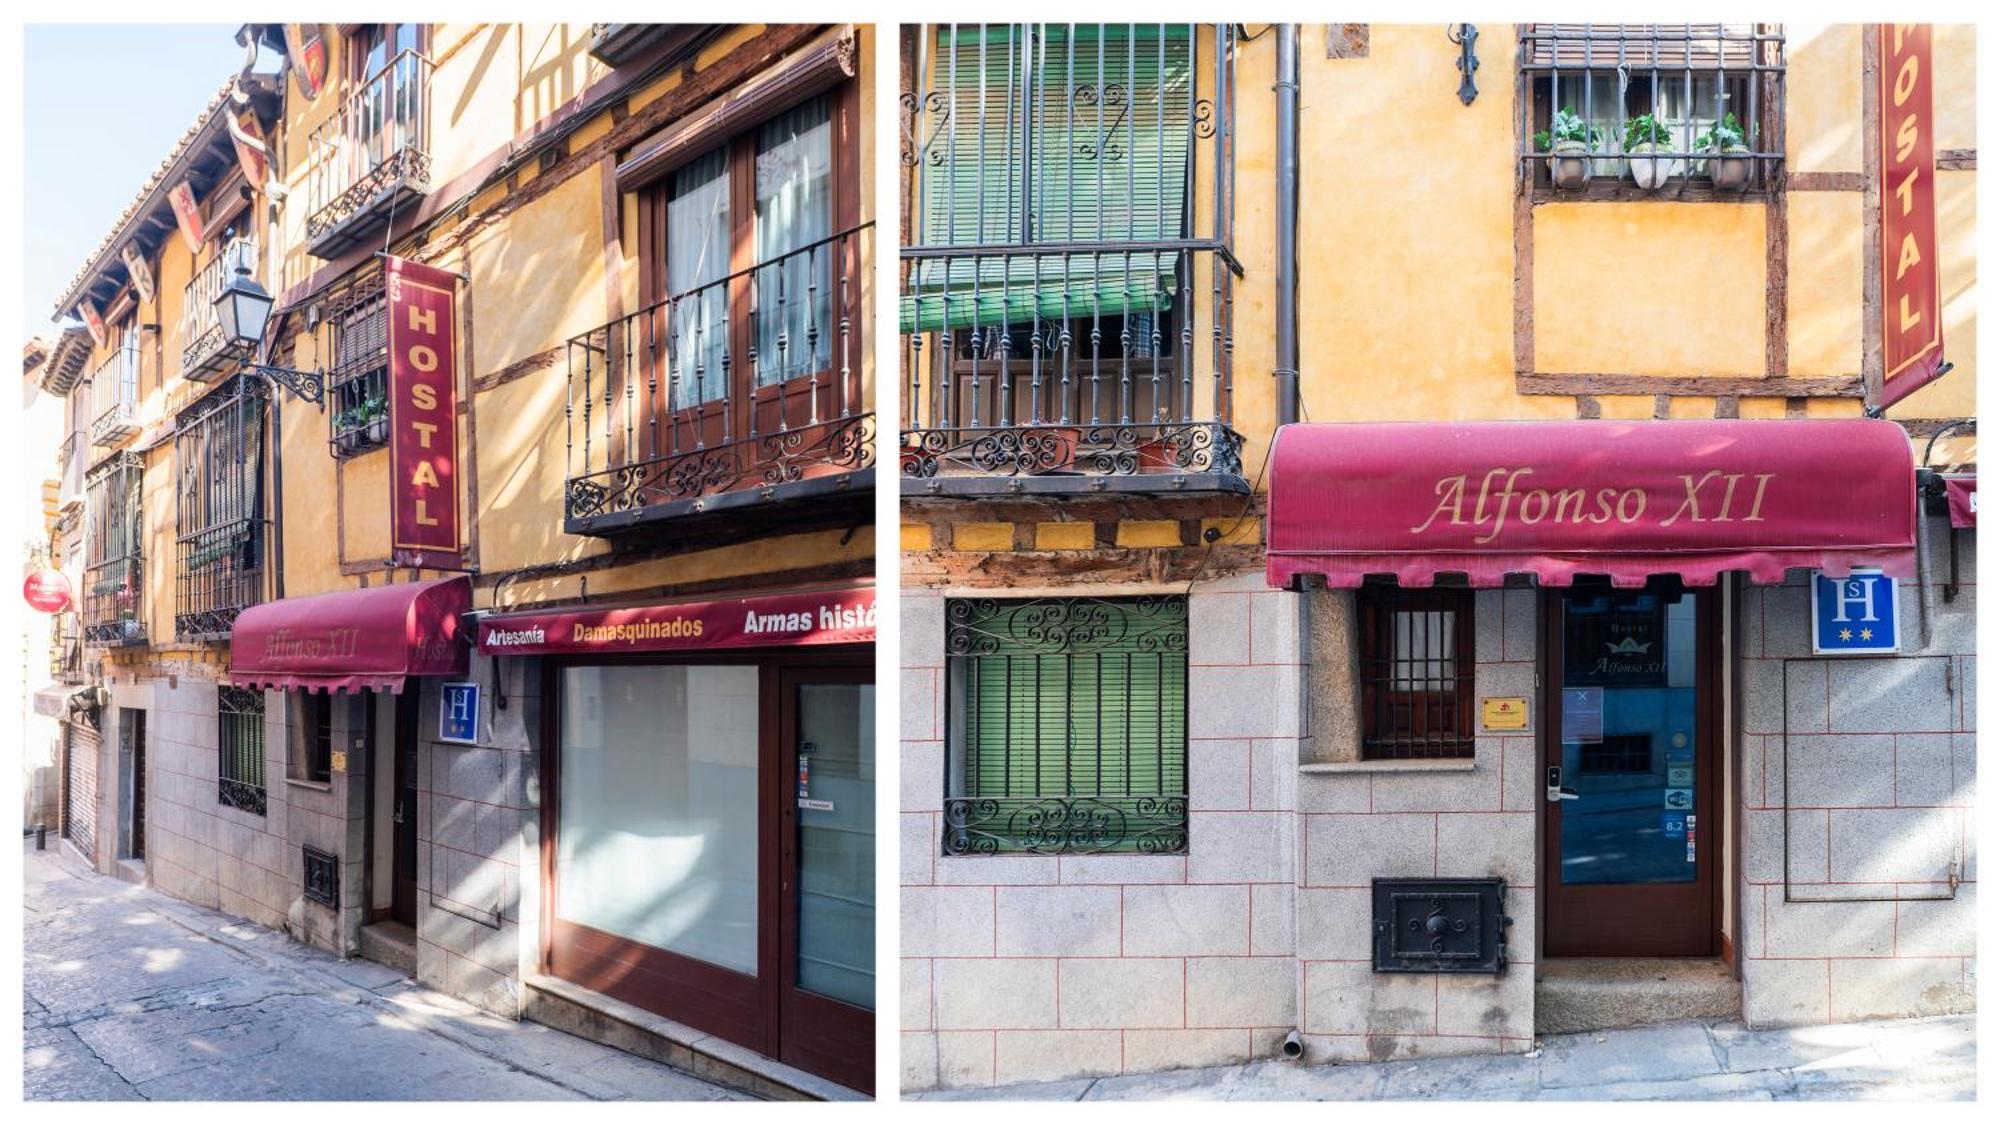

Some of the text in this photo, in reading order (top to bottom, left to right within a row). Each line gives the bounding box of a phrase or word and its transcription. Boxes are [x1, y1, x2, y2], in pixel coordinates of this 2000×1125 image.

[408, 305, 440, 526] HOSTAL
[1410, 467, 1776, 544] Alfonso XII
[486, 625, 545, 646] Artesanía
[573, 616, 703, 644] Damasquinados
[744, 610, 813, 634] Armas
[1665, 821, 1683, 832] 8.2
